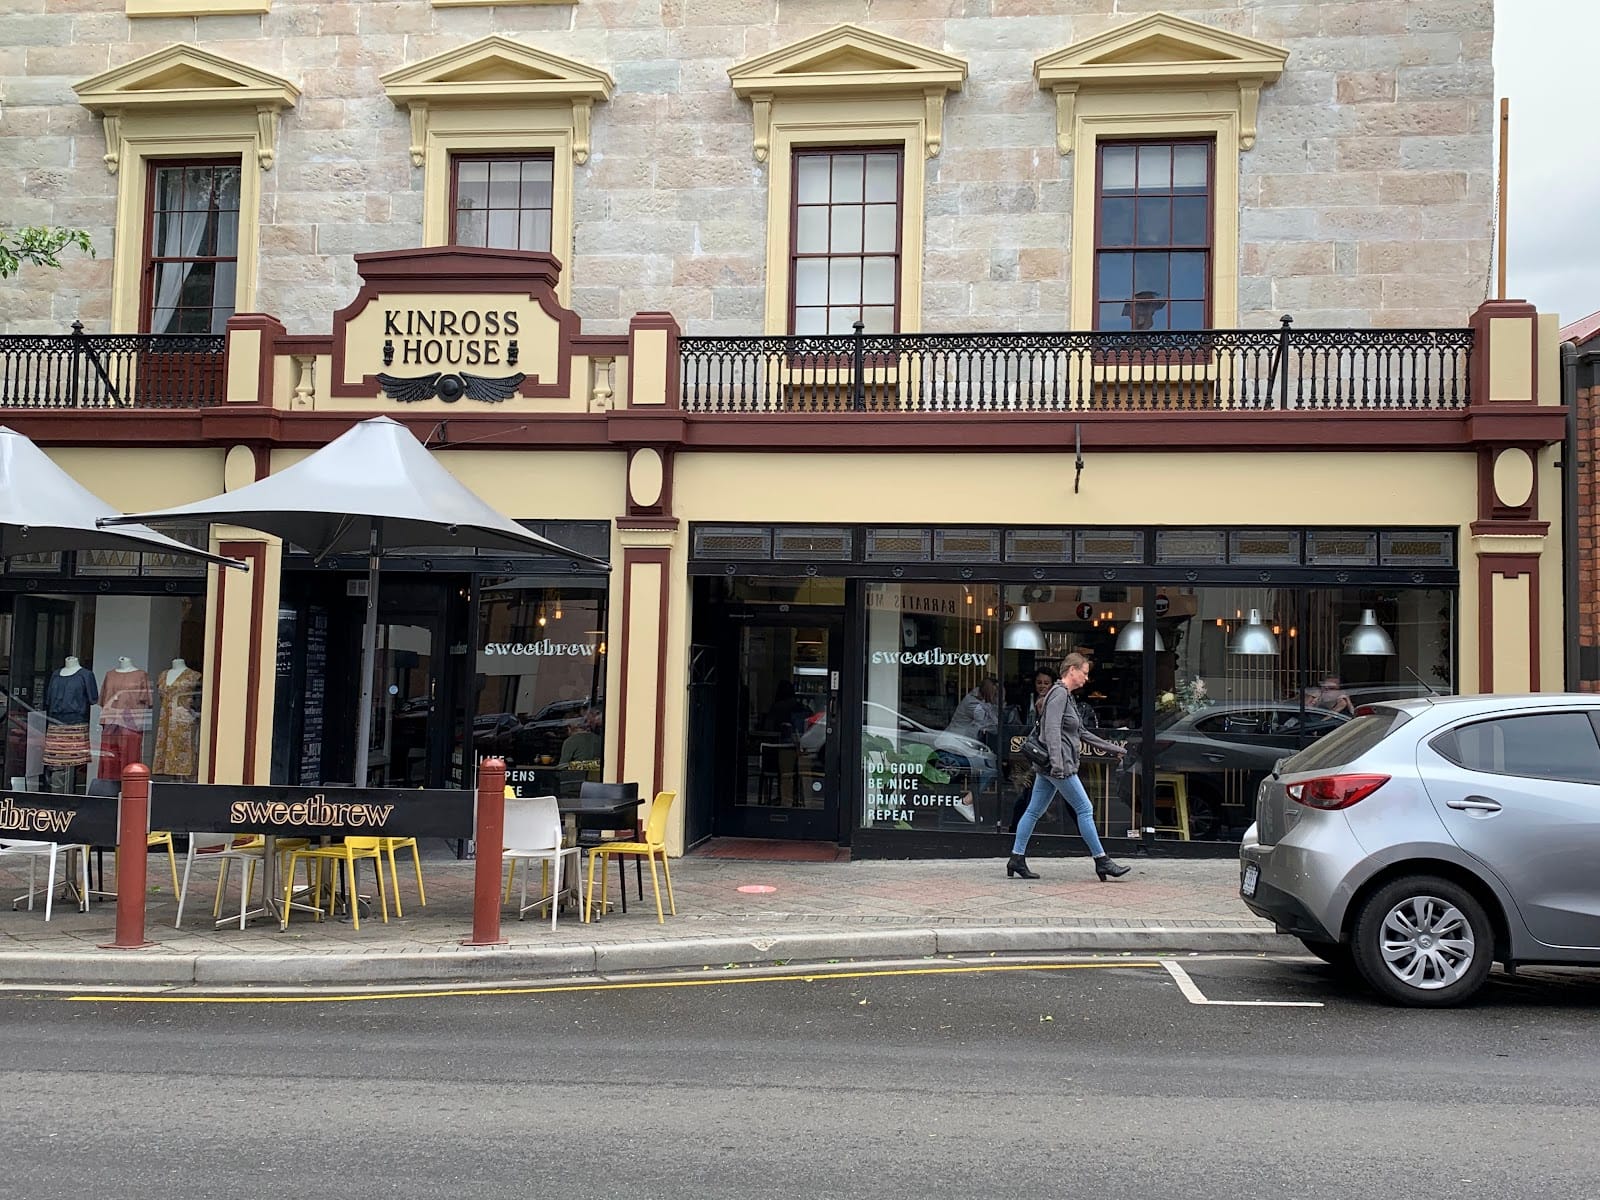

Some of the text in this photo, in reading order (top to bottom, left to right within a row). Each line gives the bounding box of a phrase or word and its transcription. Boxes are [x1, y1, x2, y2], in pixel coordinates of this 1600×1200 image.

[384, 310, 519, 336] KINROSS
[402, 339, 501, 365] HOUSE
[484, 638, 597, 657] sweetbrew
[871, 647, 991, 666] sweetbrew
[867, 763, 924, 775] DO GOOD
[867, 778, 919, 791] BE NICE
[867, 794, 960, 807] DRINK COFFEE
[229, 794, 395, 827] sweetbrew
[867, 809, 915, 822] REPEAT
